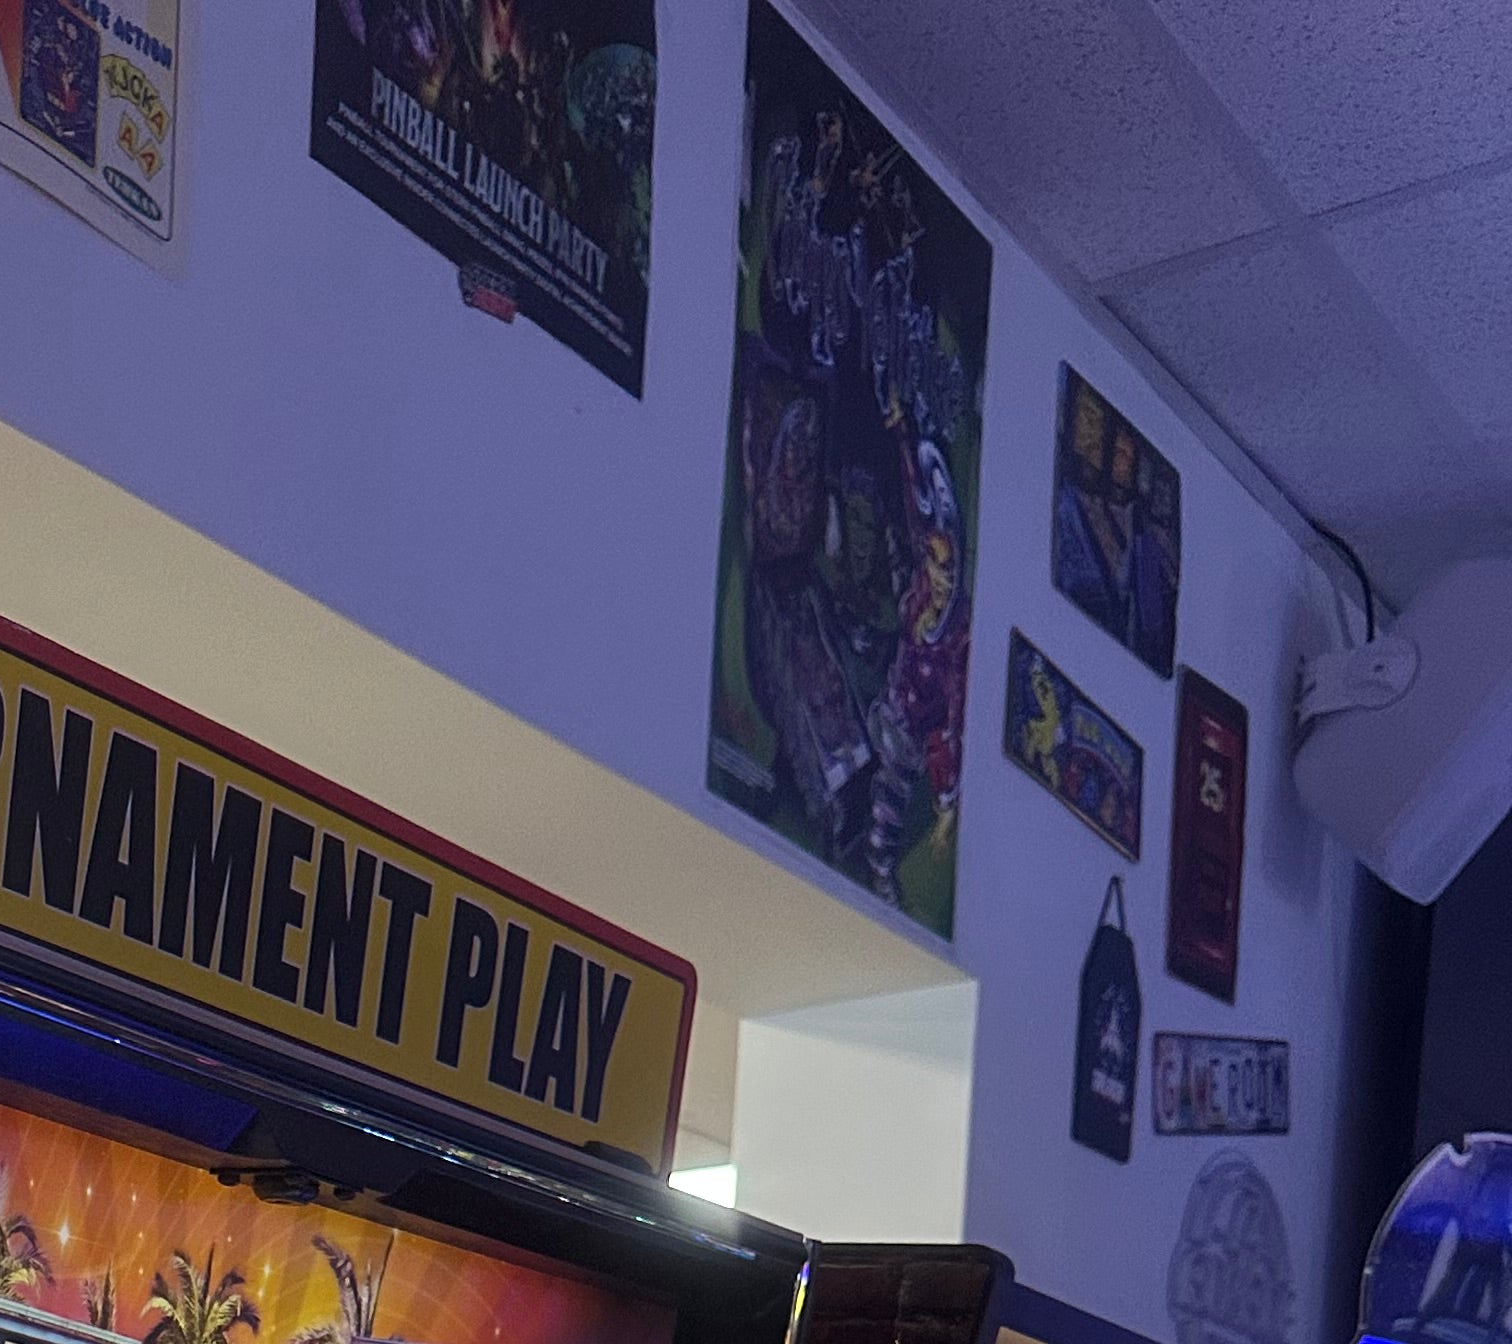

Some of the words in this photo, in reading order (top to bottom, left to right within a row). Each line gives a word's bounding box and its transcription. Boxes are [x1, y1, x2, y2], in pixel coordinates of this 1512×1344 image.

[371, 66, 459, 181] PINBALL
[463, 142, 545, 245] LAUNCH
[548, 206, 609, 293] PARTY
[435, 895, 633, 1124] PLAY
